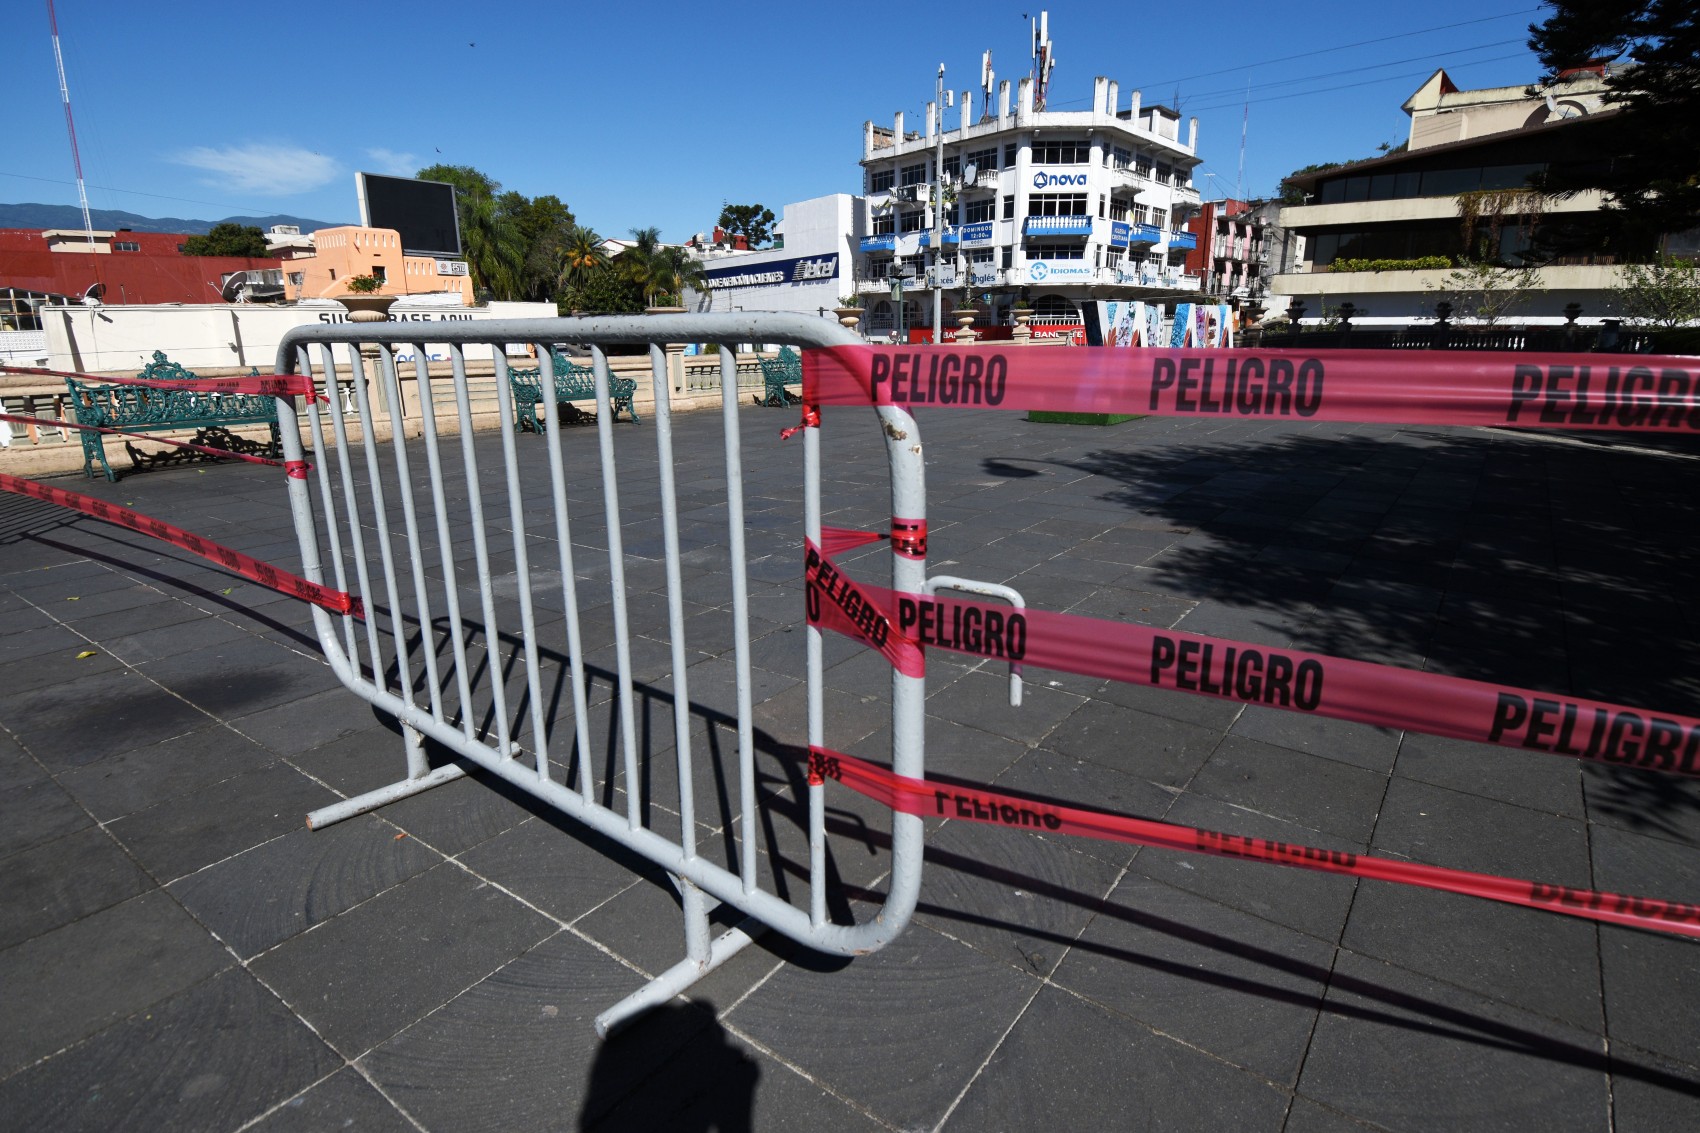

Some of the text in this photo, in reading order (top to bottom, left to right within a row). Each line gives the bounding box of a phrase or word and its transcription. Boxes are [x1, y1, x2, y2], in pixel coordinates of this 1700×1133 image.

[1048, 174, 1087, 186] nova
[963, 225, 992, 233] DOMINGOS
[871, 354, 1008, 405] PELIGRO
[1149, 357, 1325, 416] PELIGRO
[805, 548, 889, 648] PELIGRO
[898, 598, 1027, 661] PELIGRO
[1150, 635, 1324, 711] PELIGRO
